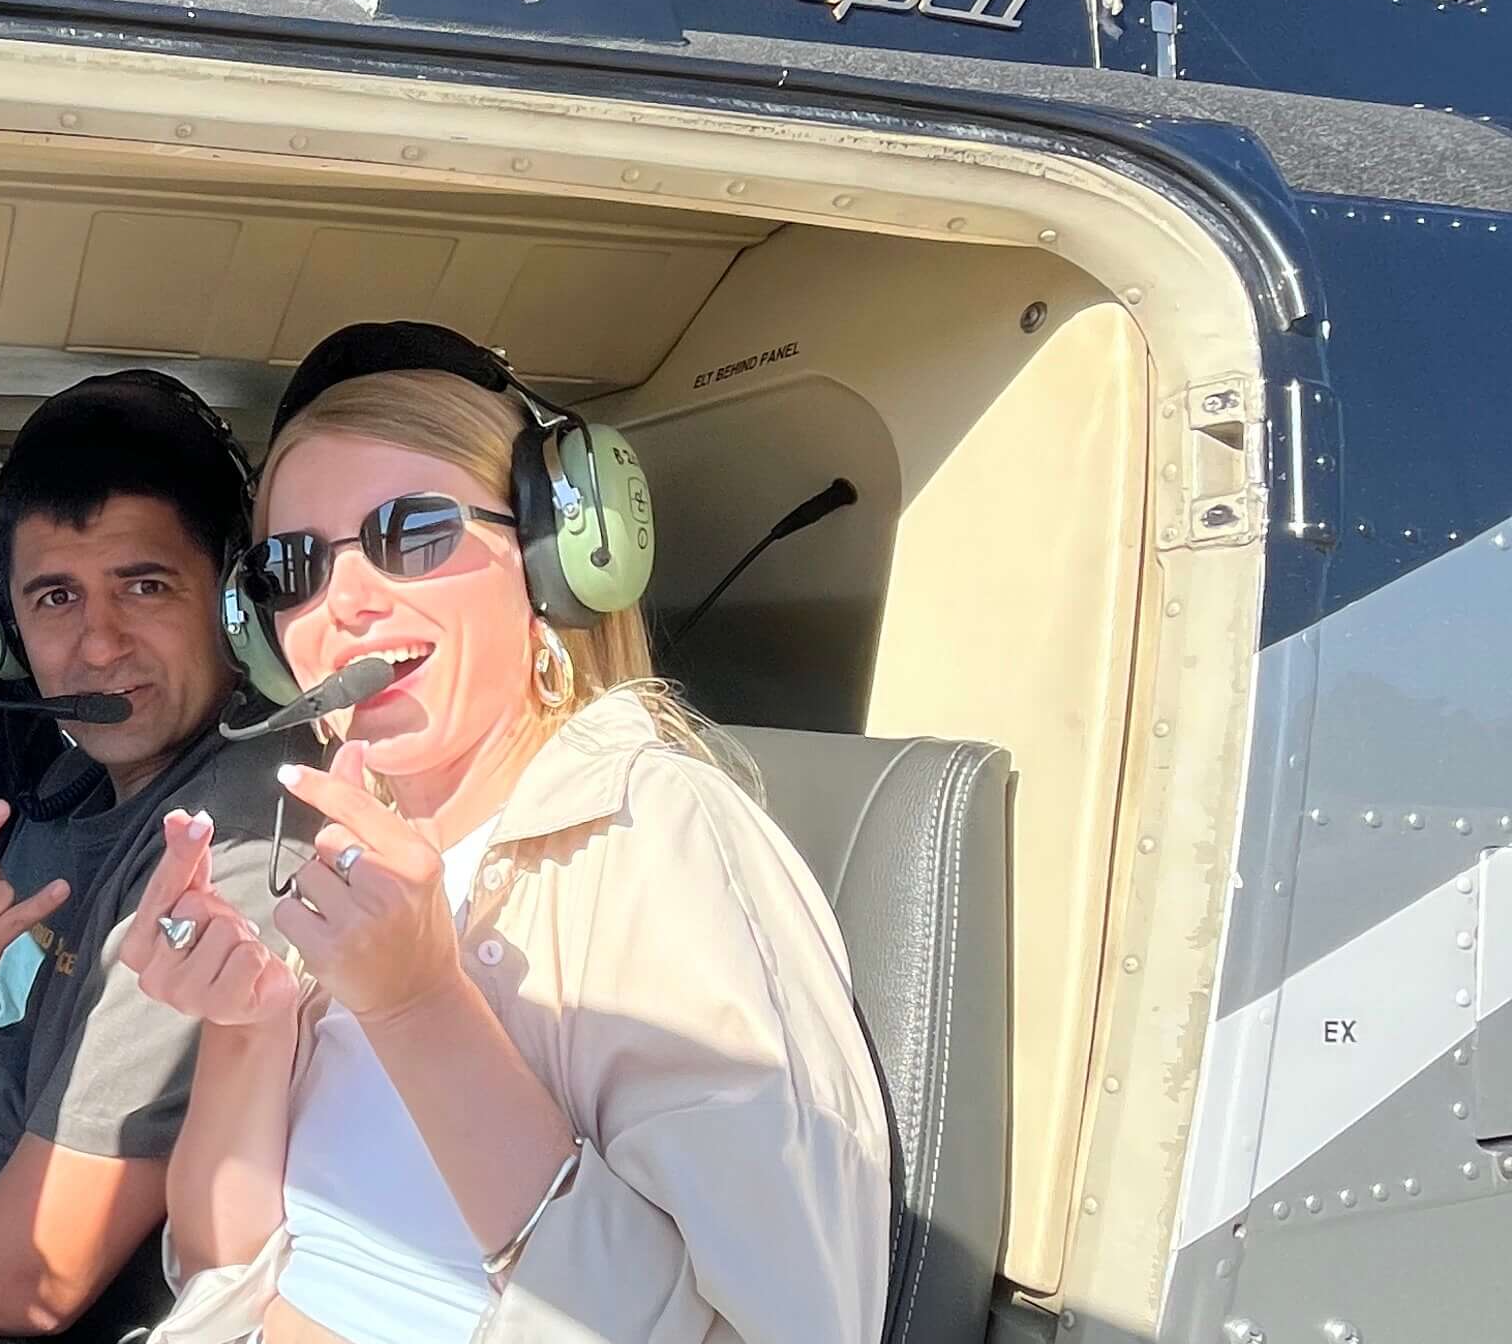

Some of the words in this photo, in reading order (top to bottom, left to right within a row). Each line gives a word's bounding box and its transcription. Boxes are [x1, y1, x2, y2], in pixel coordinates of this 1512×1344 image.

[693, 371, 714, 389] ELT
[715, 356, 758, 382] BEHIND
[759, 341, 800, 367] PANEL
[1324, 1020, 1357, 1043] EX
